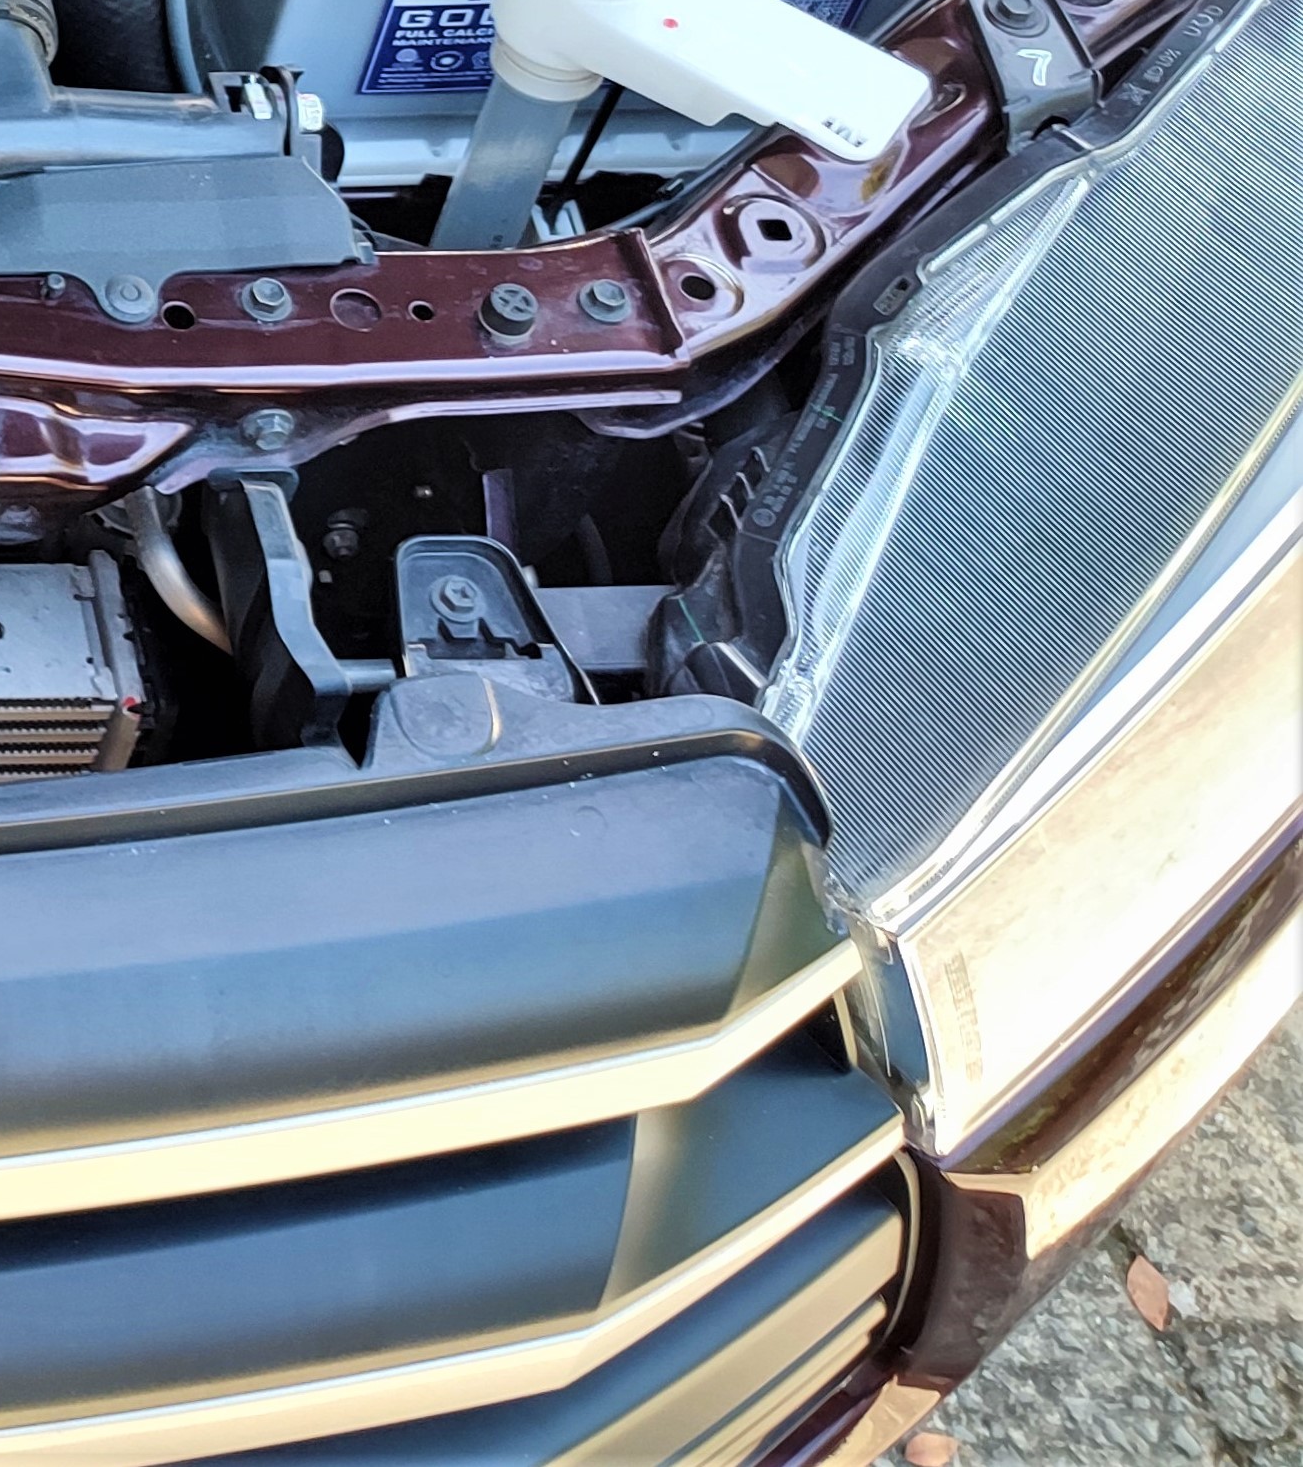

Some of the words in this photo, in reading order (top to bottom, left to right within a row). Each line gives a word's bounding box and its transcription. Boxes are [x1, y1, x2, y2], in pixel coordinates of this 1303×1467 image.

[399, 8, 494, 28] GOL
[395, 30, 438, 39] FULL
[392, 37, 493, 47] MAINTENAN
